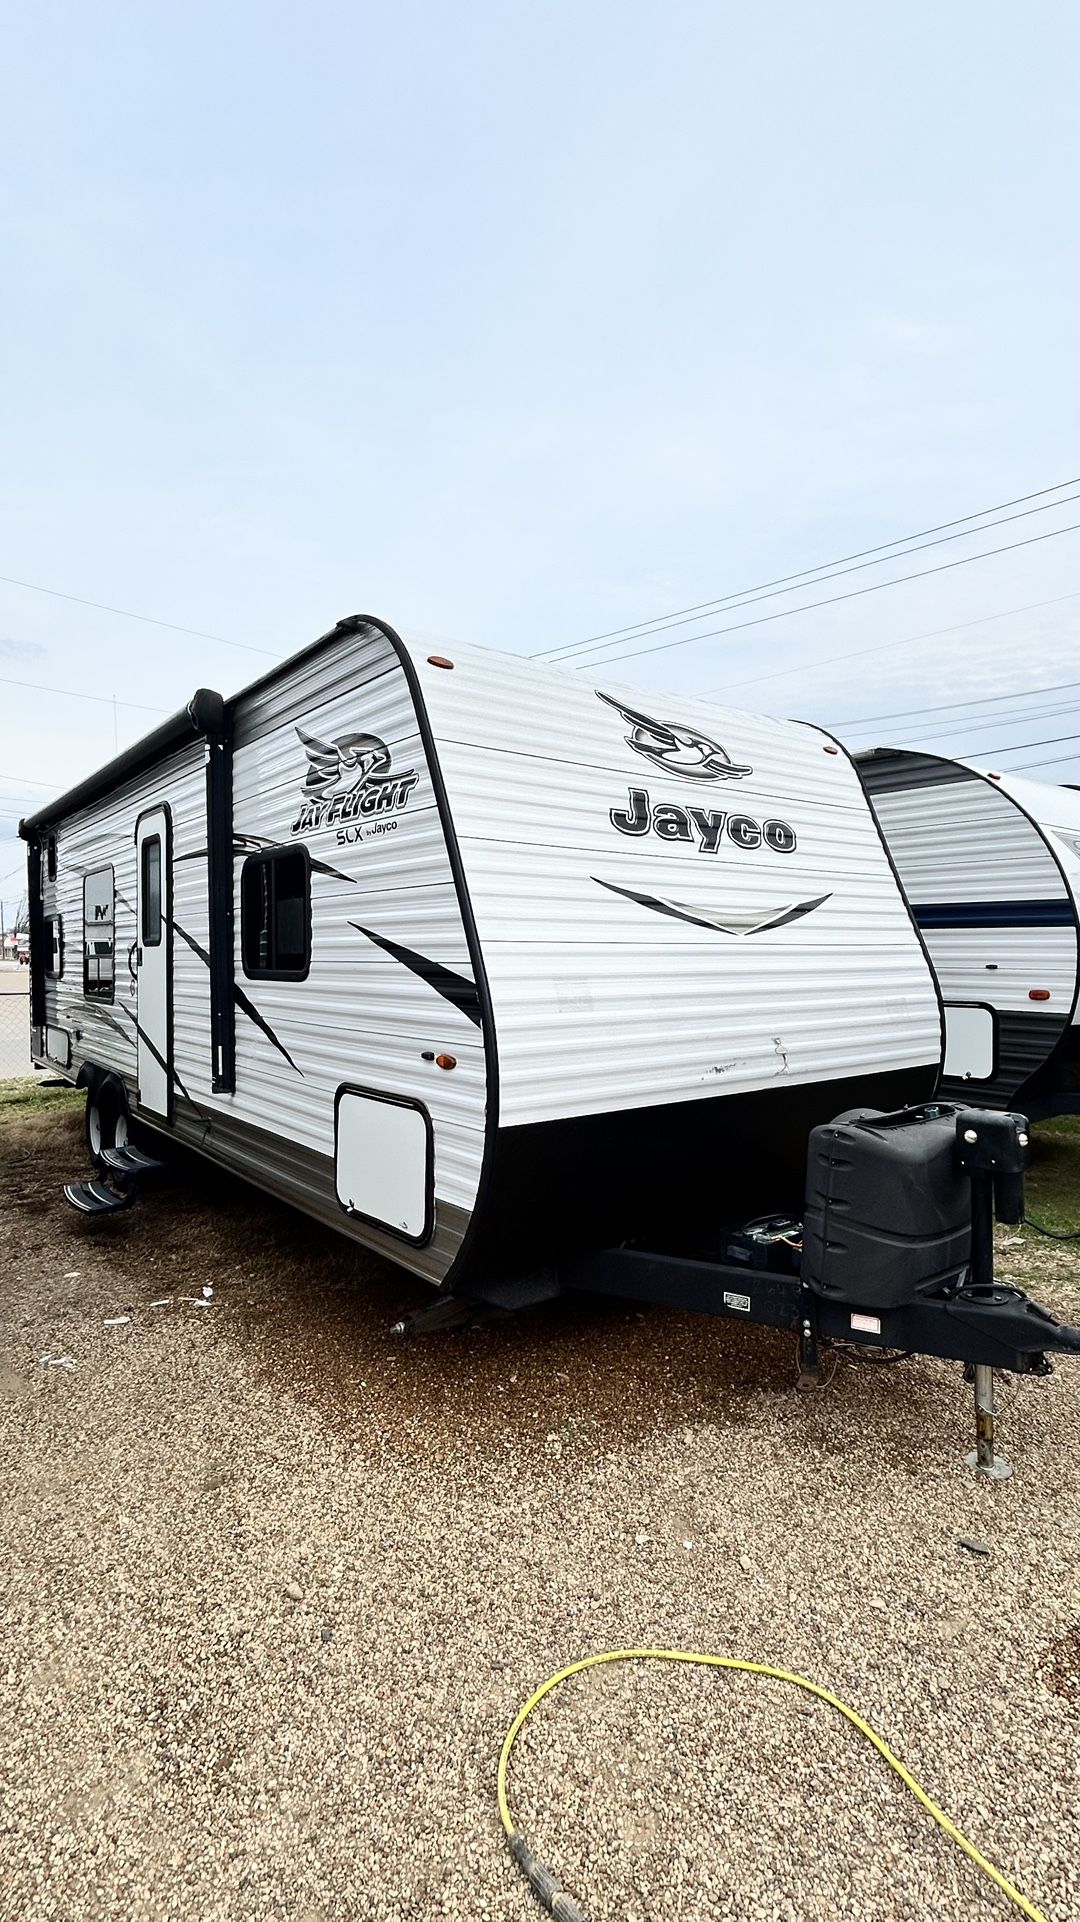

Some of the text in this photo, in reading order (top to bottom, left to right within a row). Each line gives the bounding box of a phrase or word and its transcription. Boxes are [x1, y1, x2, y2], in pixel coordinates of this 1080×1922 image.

[291, 773, 420, 836] JAY FLIGHT
[336, 826, 364, 846] SLX
[371, 820, 398, 836] Jayco
[609, 787, 797, 854] Jayco
